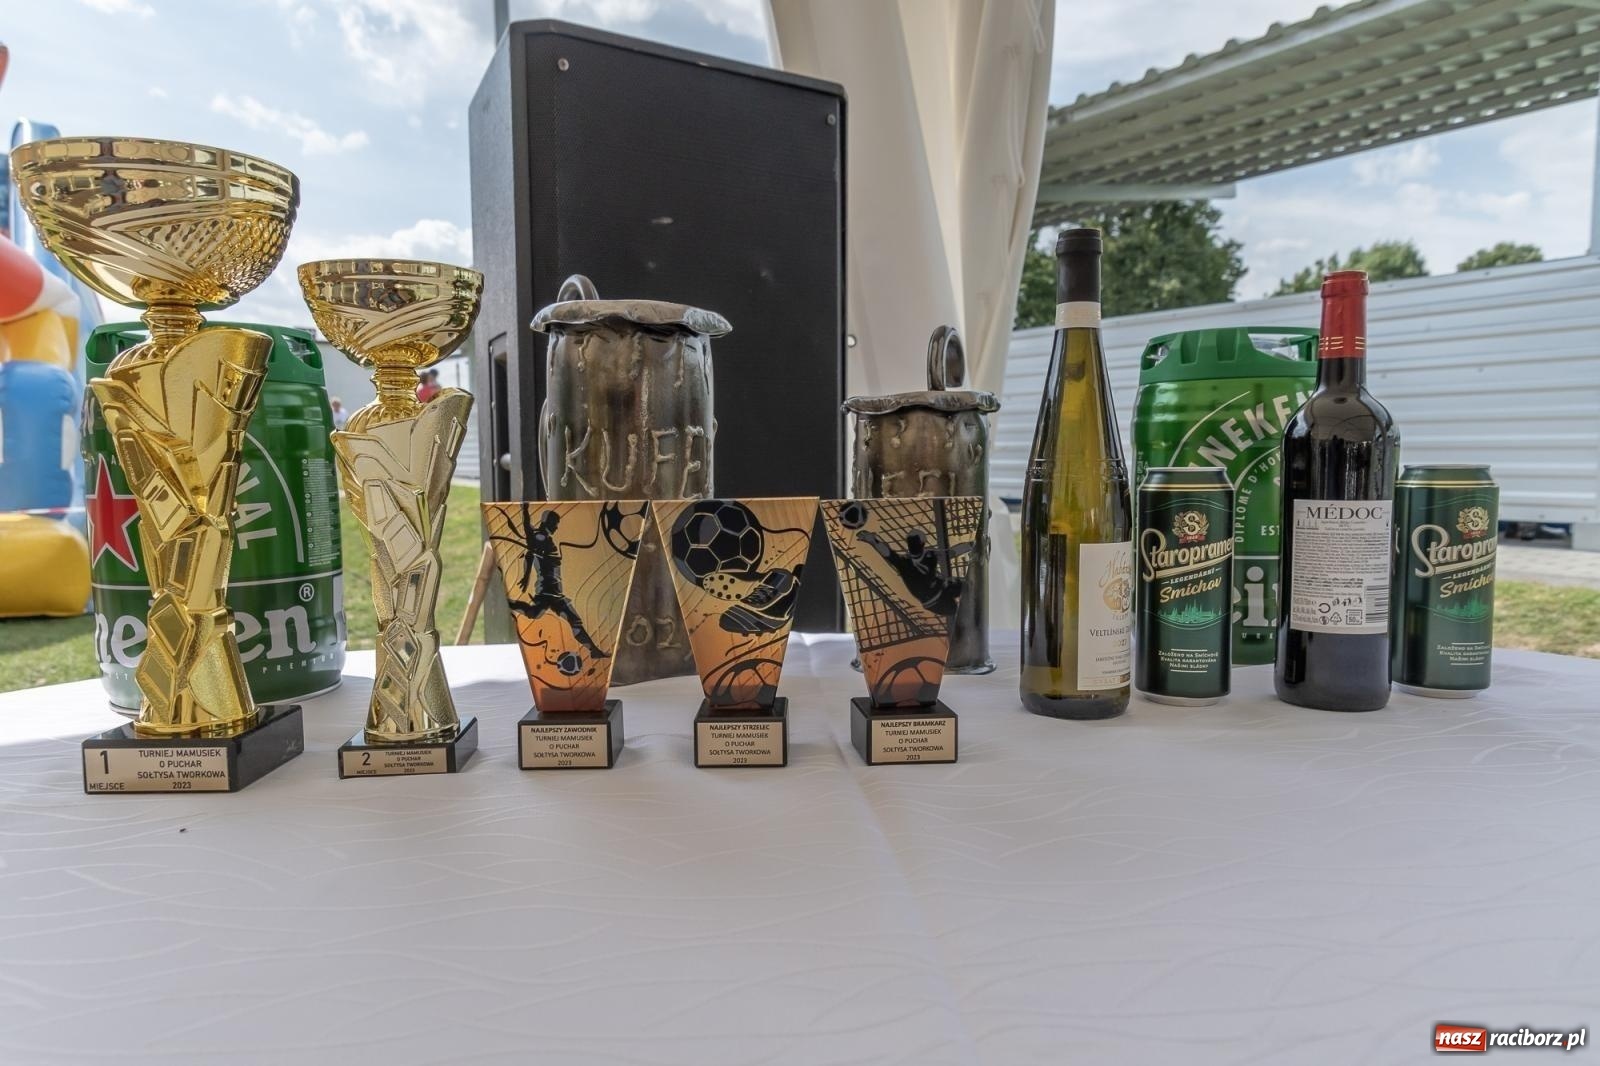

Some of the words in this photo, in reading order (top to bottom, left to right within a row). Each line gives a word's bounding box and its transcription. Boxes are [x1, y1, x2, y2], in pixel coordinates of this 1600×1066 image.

[1306, 503, 1383, 520] MÉDOC
[139, 750, 174, 758] TURNIEJ
[176, 749, 222, 757] MAMUSIEK
[100, 750, 110, 775] 1
[361, 752, 371, 766] 2
[159, 760, 165, 768] O
[167, 760, 202, 768] PUCHAR
[137, 771, 175, 779] SOŁTYSA
[89, 782, 125, 790] MIEJSCE
[172, 781, 192, 789] 2023
